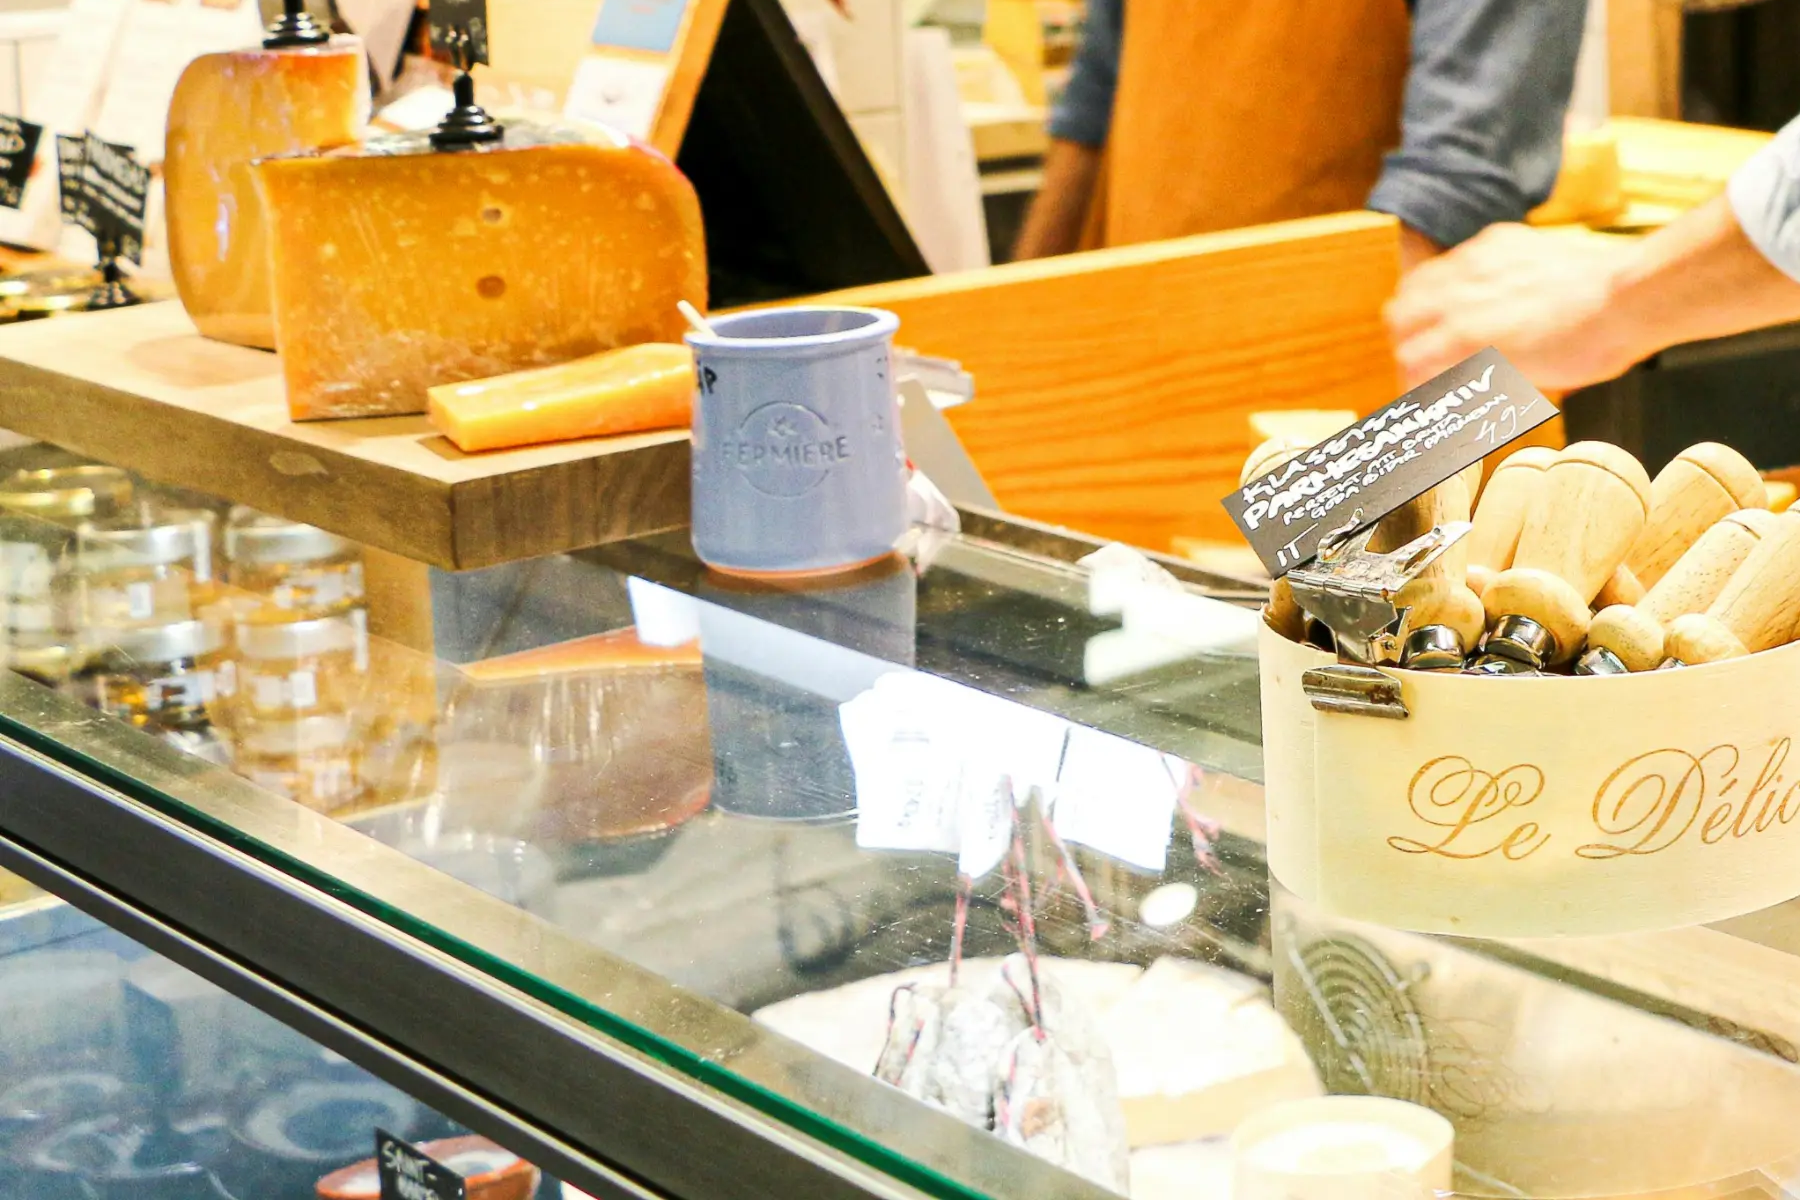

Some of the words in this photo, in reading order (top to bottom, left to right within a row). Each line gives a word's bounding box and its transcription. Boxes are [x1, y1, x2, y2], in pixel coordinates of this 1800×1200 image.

[1242, 364, 1496, 530] PARMESANKNIV
[1242, 402, 1420, 503] KLASSISK
[1283, 471, 1363, 526] PERFEKT
[1367, 449, 1397, 475] ATT
[1276, 522, 1319, 568] IT
[1310, 486, 1360, 520] GODA
[1386, 754, 1552, 861] Le
